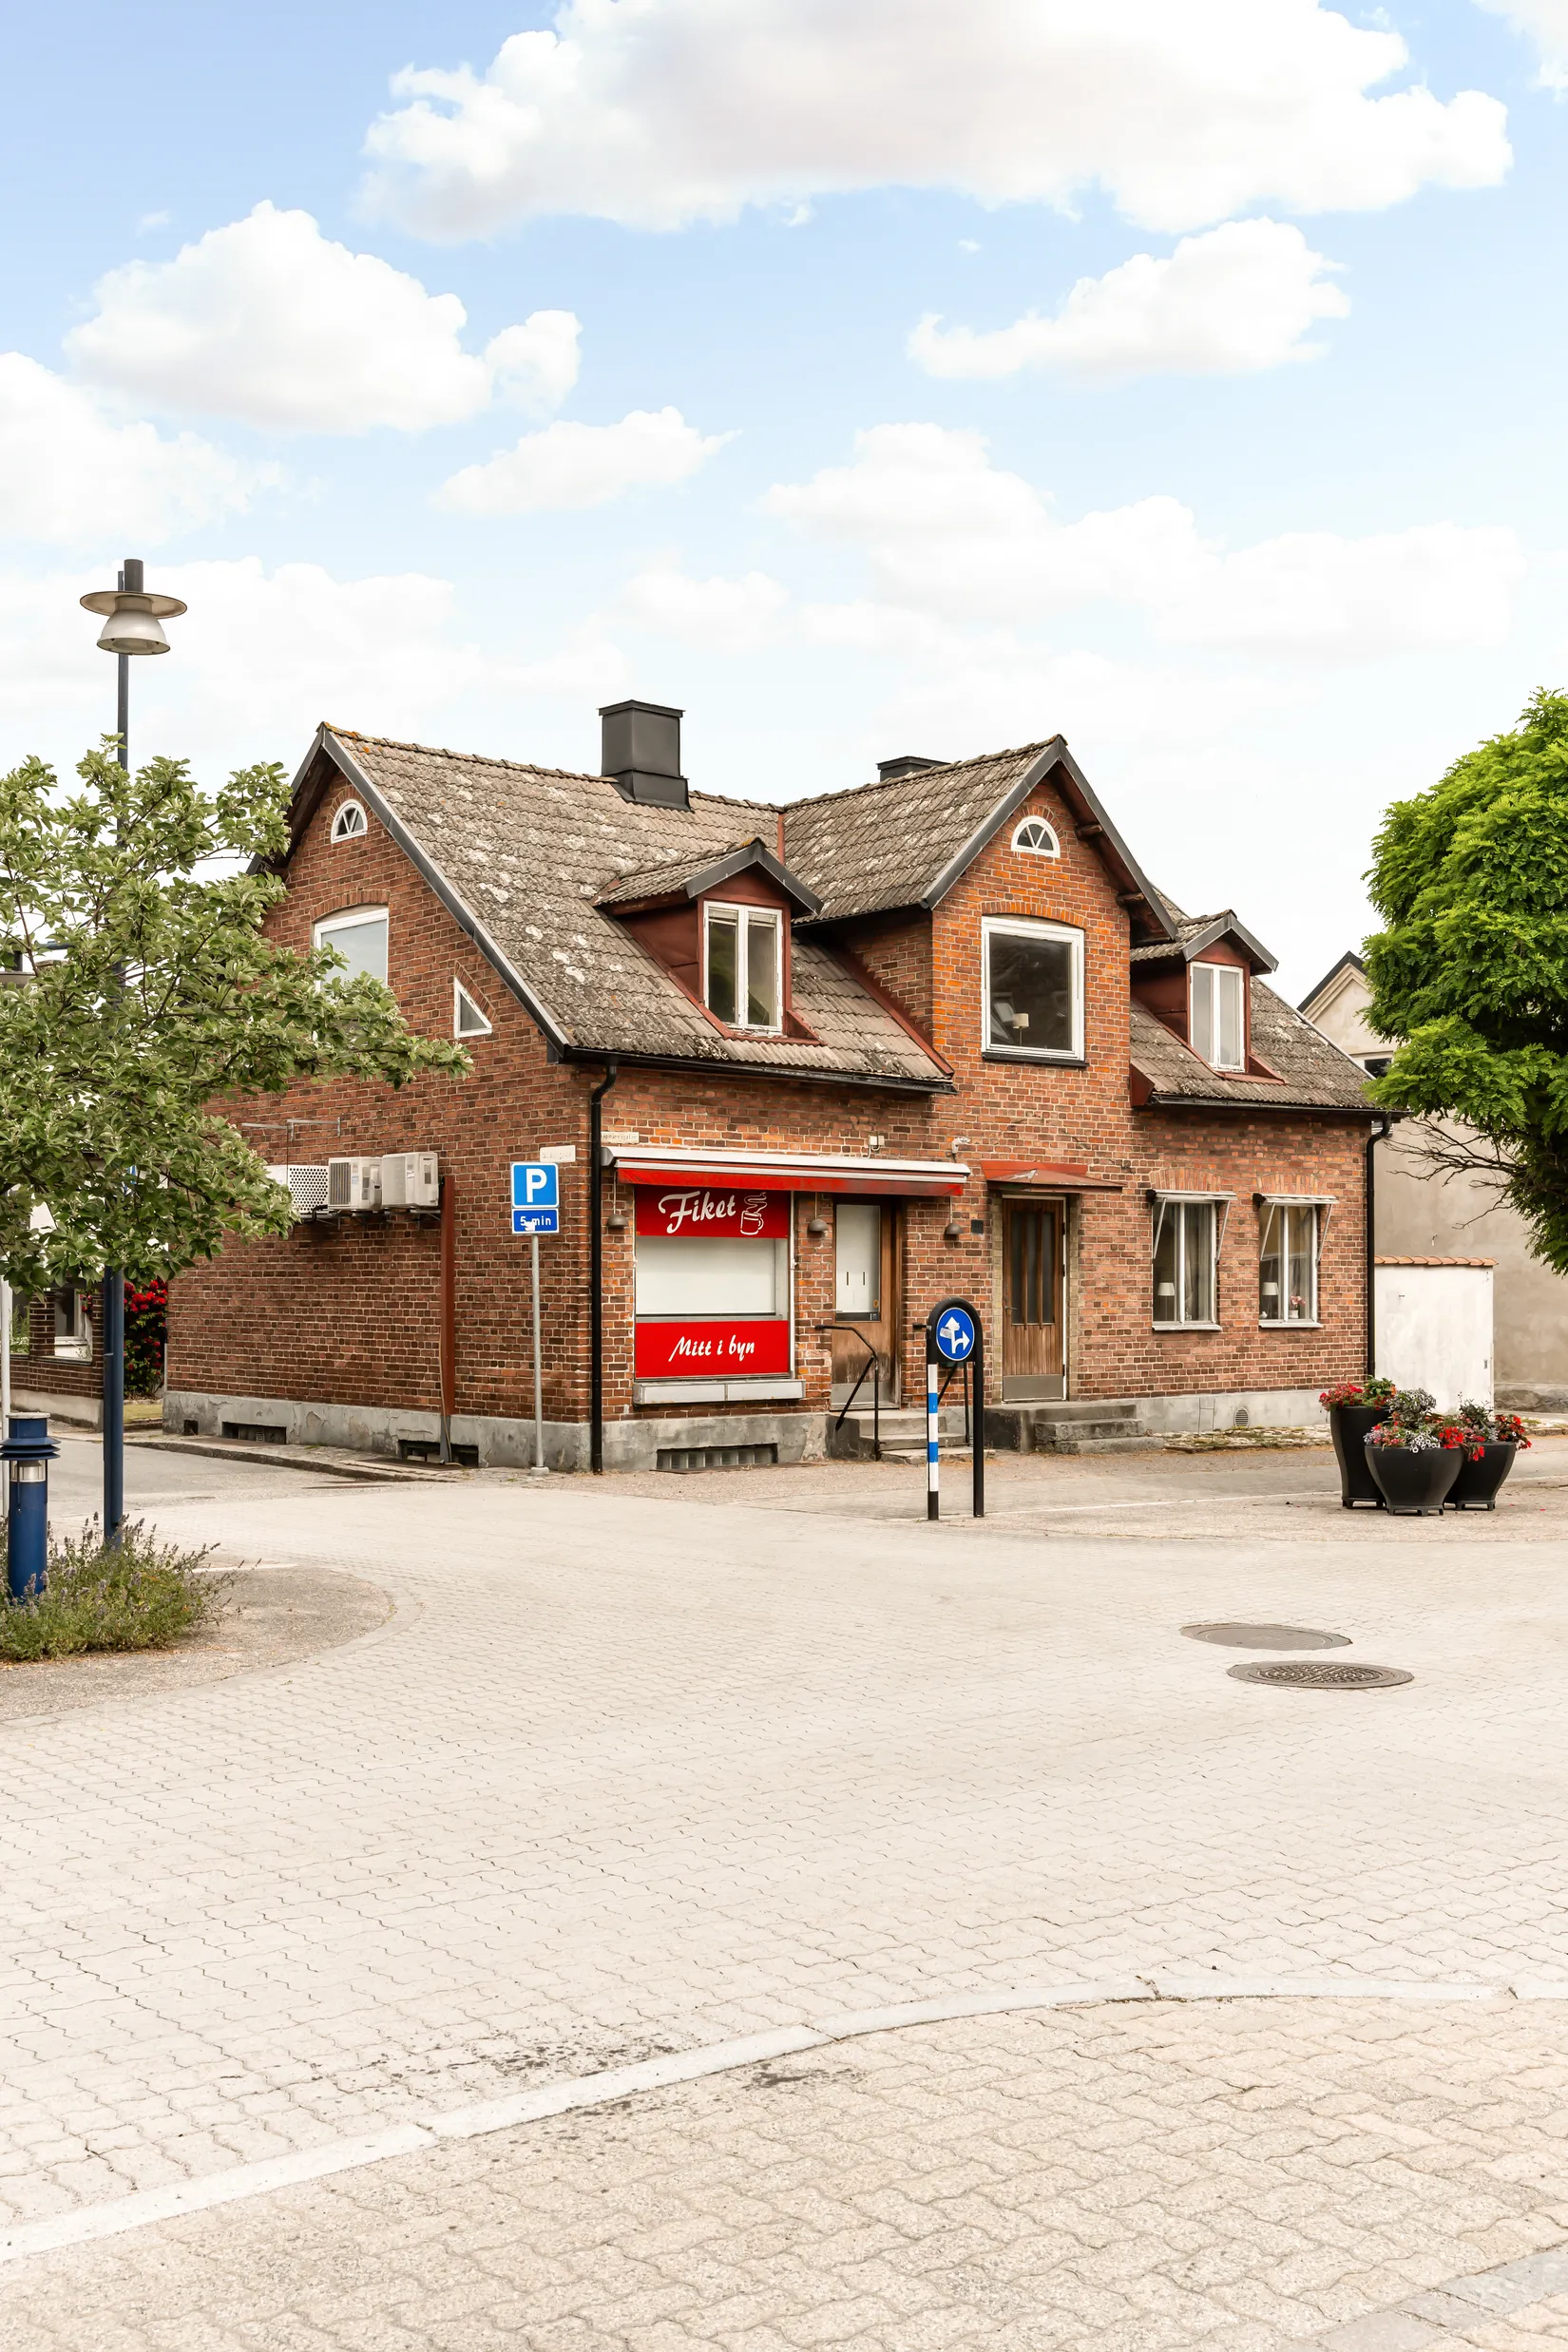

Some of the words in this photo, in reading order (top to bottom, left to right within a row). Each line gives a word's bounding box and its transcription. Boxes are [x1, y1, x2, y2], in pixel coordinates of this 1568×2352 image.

[526, 1168, 547, 1203] P
[520, 1215, 526, 1226] 5
[531, 1215, 551, 1226] min
[658, 1190, 736, 1233] Fiket
[668, 1336, 712, 1362] Mitt
[717, 1339, 723, 1355] i
[728, 1334, 755, 1362] byn
